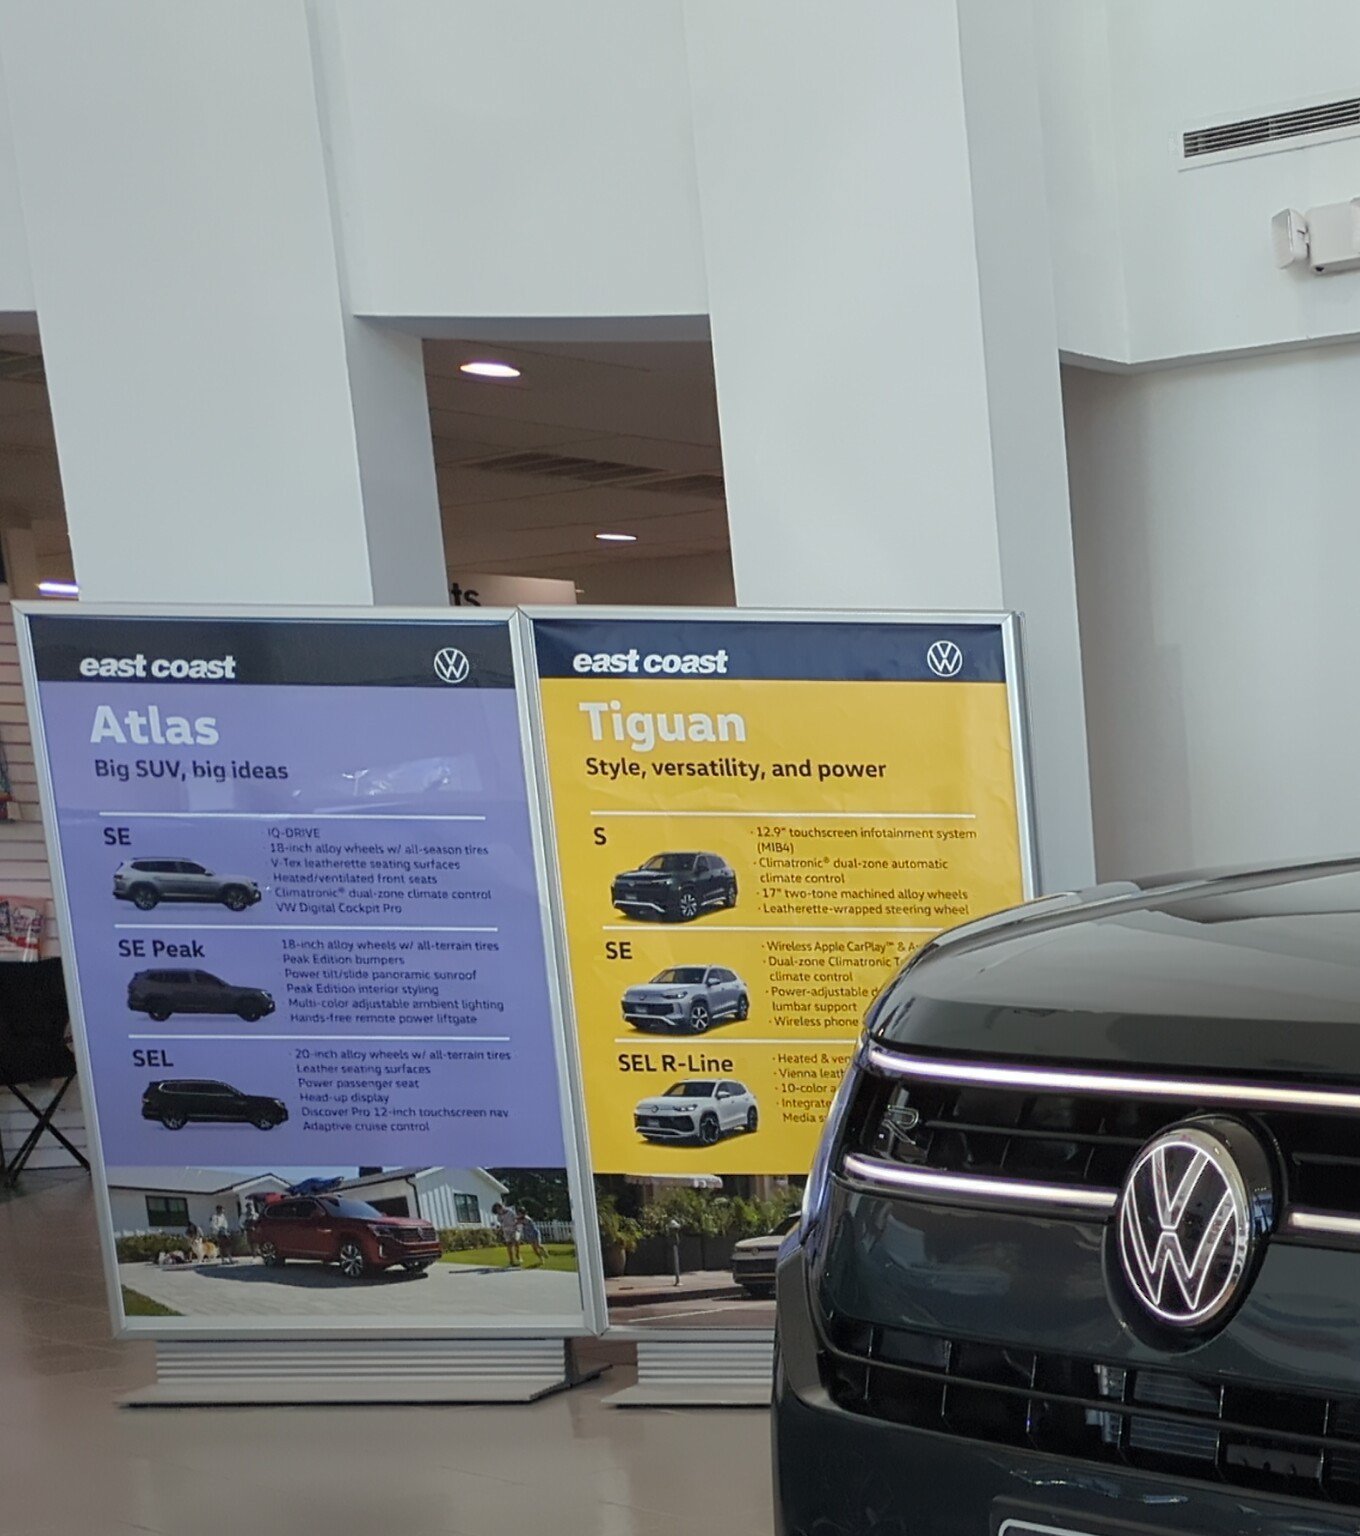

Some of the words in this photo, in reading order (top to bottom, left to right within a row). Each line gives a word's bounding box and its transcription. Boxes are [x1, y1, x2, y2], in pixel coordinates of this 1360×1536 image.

[434, 647, 469, 683] VW
[573, 648, 639, 673] east
[644, 649, 728, 674] coast
[927, 640, 963, 677] VW
[79, 653, 147, 679] east
[151, 655, 236, 680] coast
[90, 704, 219, 746] Atlas
[579, 701, 746, 752] Tiguan
[95, 759, 130, 780] Big
[136, 760, 187, 782] SUV,
[193, 760, 226, 782] big
[231, 760, 289, 780] ideas
[586, 757, 647, 781] Style,
[652, 757, 766, 781] versatility,
[772, 759, 812, 778] and
[818, 761, 887, 781] power
[104, 827, 131, 845] SE
[593, 827, 607, 846] S
[789, 827, 858, 838] touchscreen
[860, 827, 933, 839] infotainment
[936, 829, 977, 841] system
[270, 843, 312, 854] 18-inch
[315, 844, 342, 856] alloy
[345, 844, 384, 855] wheels
[387, 844, 402, 855] w/
[404, 844, 462, 855] all-season
[465, 845, 489, 855] tires
[757, 841, 794, 854] (MIB4)
[304, 858, 367, 869] leatherette
[370, 859, 411, 872] seating
[413, 859, 460, 870] surfaces
[833, 858, 889, 869] dual-zone
[891, 859, 948, 870] automatic
[273, 873, 374, 884] Heated/ventilated
[377, 873, 405, 884] front
[408, 875, 438, 885] seats
[760, 873, 802, 884] climate
[805, 873, 845, 884] control
[348, 888, 404, 900] dual-zone
[407, 889, 448, 900] climate
[452, 889, 492, 900] control
[784, 889, 838, 899] two-tone
[840, 889, 895, 900] machined
[897, 889, 924, 902] alloy
[927, 890, 968, 900] wheels
[276, 903, 297, 913] VW
[299, 902, 336, 915] Digital
[339, 902, 380, 915] Cockpit
[383, 903, 402, 914] Pro
[763, 904, 883, 916] Leatherette-wrapped
[885, 905, 931, 917] steering
[934, 905, 969, 915] wheel
[118, 939, 144, 957] SE
[152, 939, 205, 958] Peak
[281, 939, 324, 950] 18-inch
[327, 939, 354, 952] alloy
[357, 939, 397, 951] wheels
[399, 940, 414, 951] w/
[417, 940, 472, 951] all-terrain
[475, 941, 499, 951] tires
[605, 941, 632, 960] SE
[766, 941, 812, 952] Wireless
[814, 942, 843, 954] Apple
[897, 941, 905, 952] &
[283, 954, 310, 965] Peak
[313, 954, 352, 965] Edition
[355, 954, 405, 967] bumpers
[768, 957, 825, 967] Dual-zone
[828, 956, 891, 967] Climatronic
[285, 968, 320, 979] Power
[322, 968, 369, 980] tilt/slide
[372, 970, 430, 982] panoramic
[434, 969, 477, 981] sunroof
[769, 972, 810, 982] climate
[813, 972, 853, 982] control
[286, 983, 313, 994] Peak
[316, 983, 355, 994] Edition
[358, 983, 399, 994] interior
[401, 984, 439, 997] styling
[771, 987, 869, 999] Power-adjustable
[288, 998, 349, 1009] Multi-color
[352, 998, 409, 1011] adjustable
[412, 998, 458, 1010] ambient
[462, 999, 504, 1012] lighting
[772, 1001, 812, 1012] lumbar
[814, 1002, 857, 1014] support
[290, 1012, 351, 1023] Hands-free
[355, 1014, 396, 1024] remote
[399, 1015, 433, 1026] power
[436, 1012, 477, 1026] liftgate
[775, 1016, 821, 1027] Wireless
[824, 1017, 859, 1028] phone
[133, 1049, 174, 1067] SEL
[295, 1048, 338, 1060] 20-inch
[340, 1049, 367, 1062] alloy
[369, 1049, 409, 1060] wheels
[412, 1049, 427, 1060] w/
[429, 1049, 485, 1061] all-terrain
[487, 1050, 511, 1061] tires
[778, 1054, 818, 1064] Heated
[821, 1054, 829, 1064] &
[832, 1056, 851, 1064] ven
[618, 1054, 657, 1072] SEL
[662, 1054, 734, 1072] R-Line
[296, 1064, 338, 1074] Leather
[341, 1064, 382, 1077] seating
[384, 1064, 431, 1075] surfaces
[779, 1068, 817, 1079] Vienna
[298, 1078, 333, 1088] Power
[336, 1080, 393, 1091] passenger
[396, 1079, 420, 1089] seat
[781, 1083, 827, 1093] 10-color
[300, 1092, 348, 1104] Head-up
[351, 1092, 390, 1104] display
[782, 1098, 832, 1110] Integrate
[301, 1107, 349, 1118] Discover
[352, 1107, 371, 1118] Pro
[374, 1107, 416, 1118] 12-inch
[419, 1107, 487, 1119] touchscreen
[489, 1109, 509, 1119] nav
[783, 1113, 816, 1123] Media
[303, 1121, 352, 1133] Adaptive
[355, 1121, 388, 1132] cruise
[390, 1121, 430, 1132] control
[1119, 1134, 1247, 1322] VW
